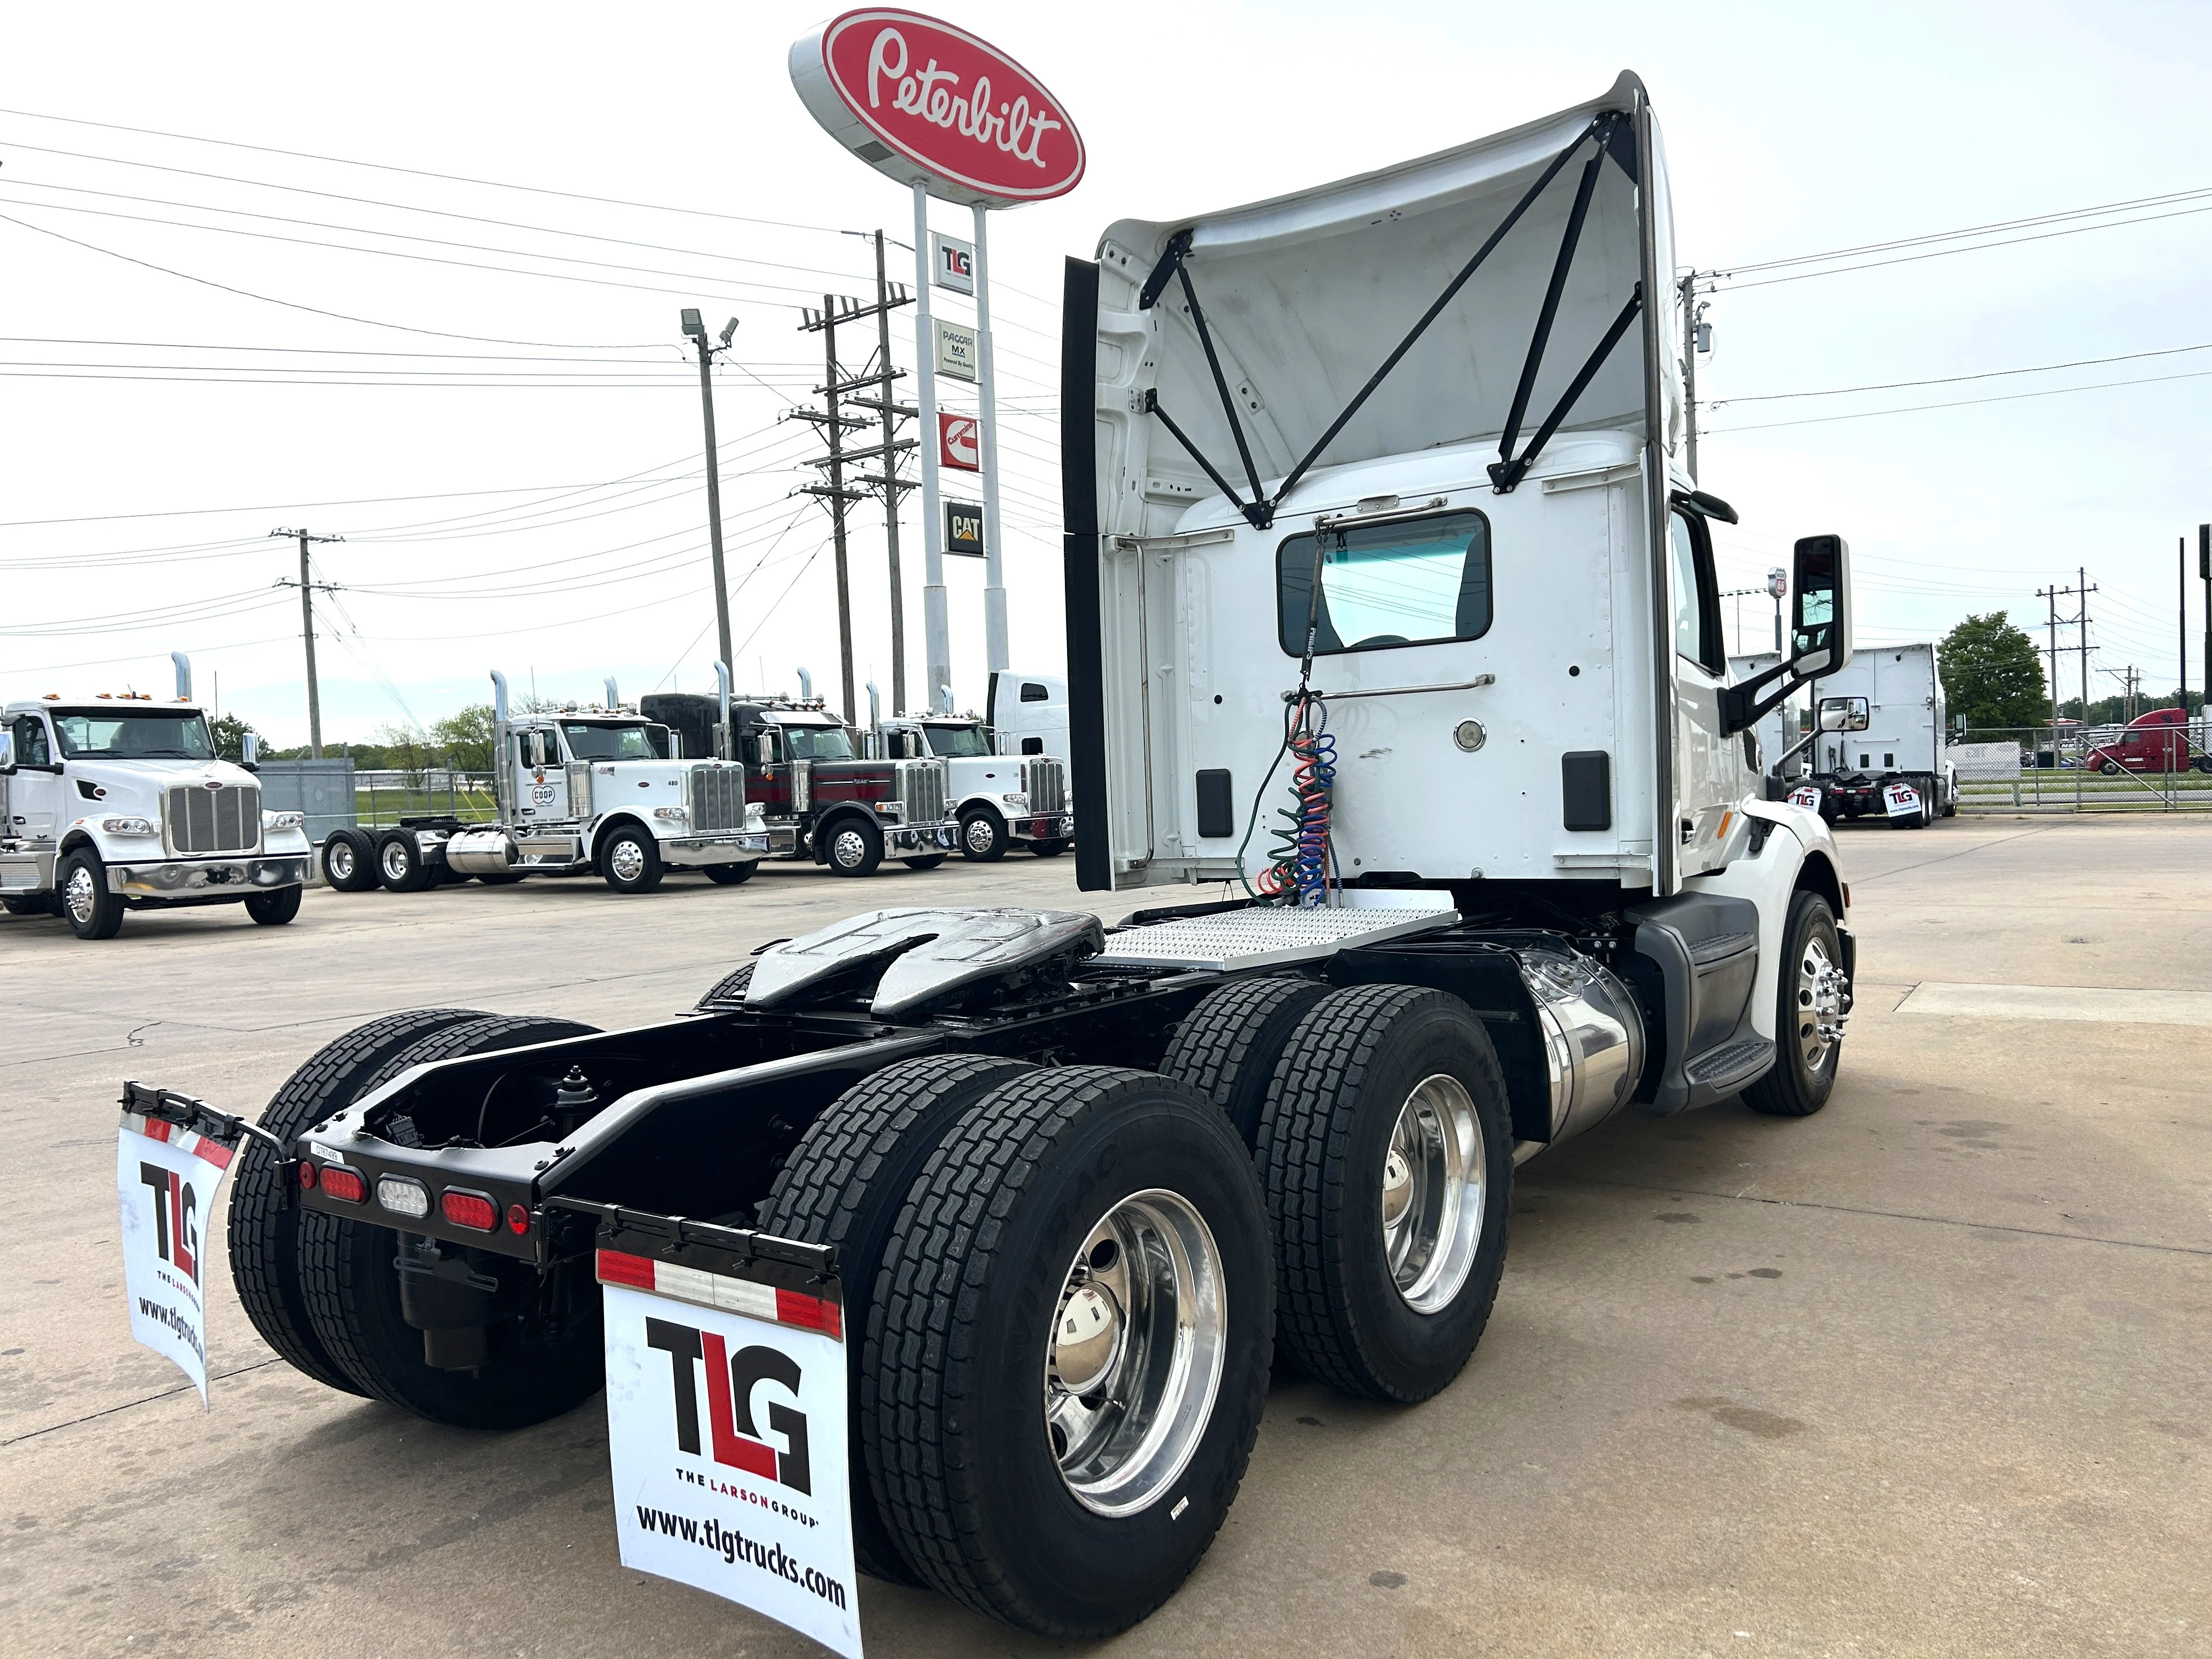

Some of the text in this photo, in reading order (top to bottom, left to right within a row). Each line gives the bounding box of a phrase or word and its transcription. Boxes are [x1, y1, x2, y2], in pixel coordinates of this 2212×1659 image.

[868, 27, 1061, 168] Peterbilt
[942, 245, 970, 276] TLG
[943, 331, 973, 346] PACCAR
[952, 345, 965, 355] MX
[944, 357, 957, 365] Powered
[947, 422, 973, 445] Cummins
[952, 516, 979, 541] CAT
[1778, 580, 1784, 591] 66
[534, 791, 552, 799] COOP
[1795, 794, 1814, 806] TLG
[1889, 791, 1912, 804] TLG
[140, 1161, 199, 1290] TLG
[157, 1271, 171, 1283] THE
[172, 1278, 191, 1299] LARSON
[646, 1316, 811, 1497] TLG
[676, 1468, 816, 1528] THE LARSON GROUP
[636, 1505, 846, 1611] www.tlgtrucks.com
